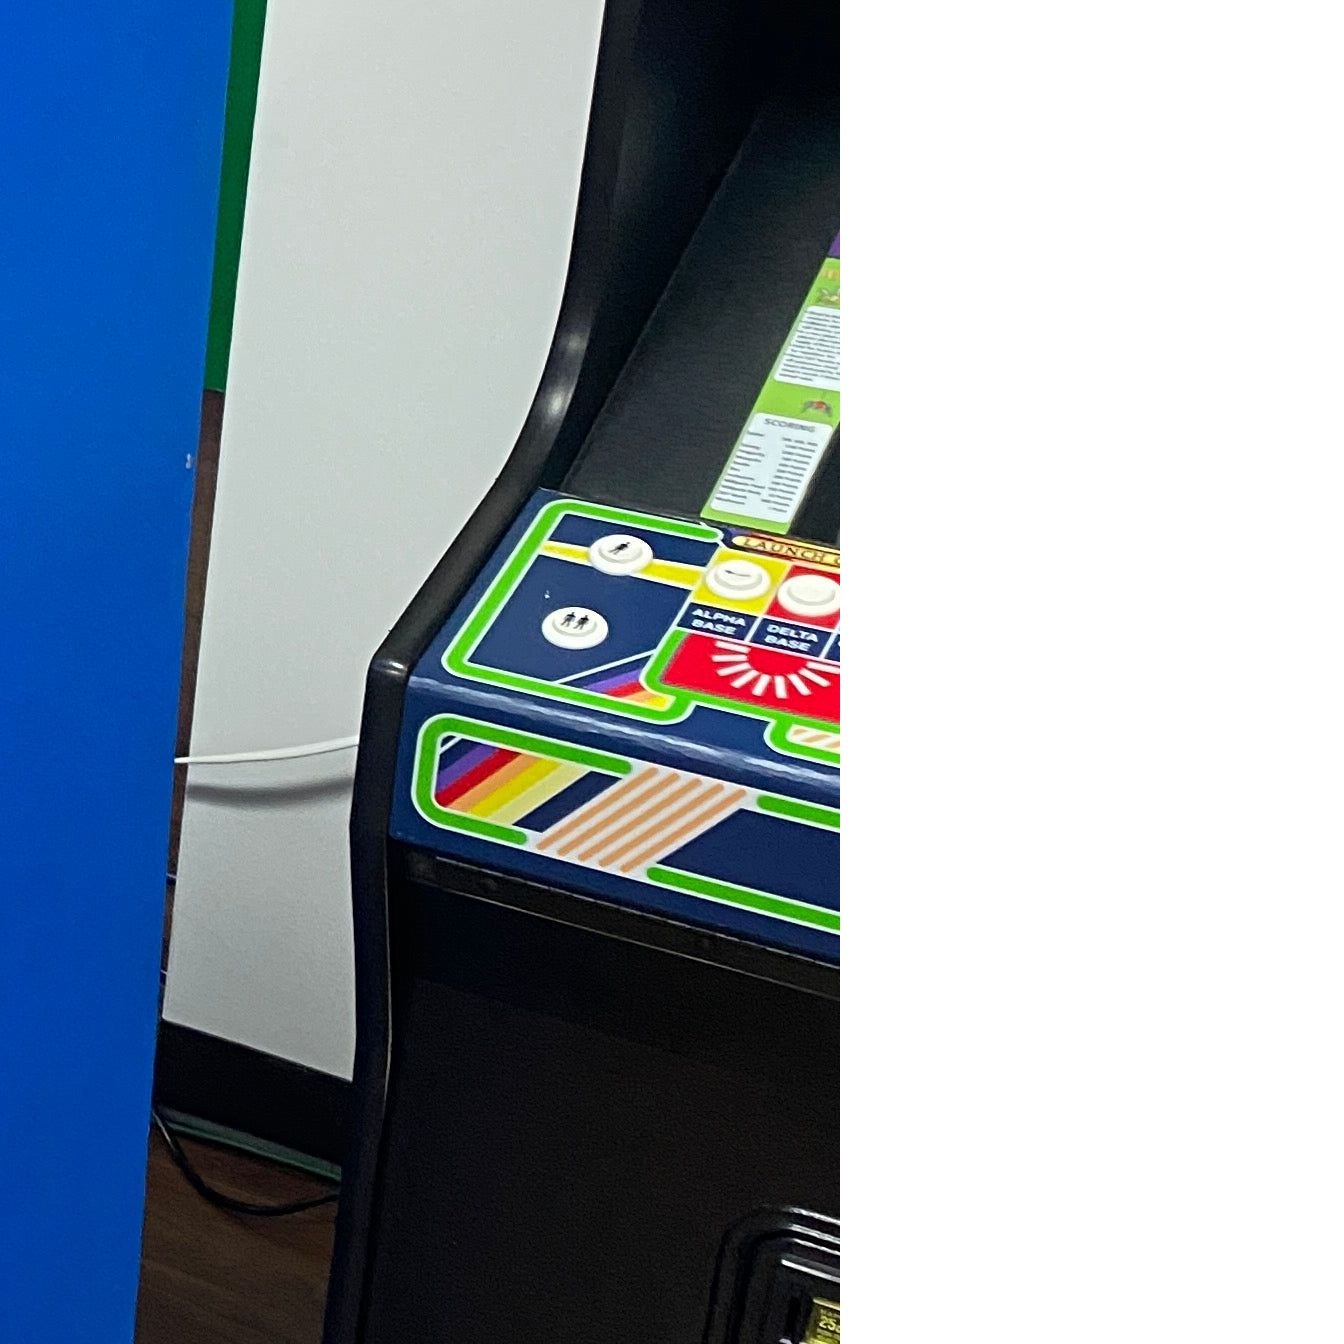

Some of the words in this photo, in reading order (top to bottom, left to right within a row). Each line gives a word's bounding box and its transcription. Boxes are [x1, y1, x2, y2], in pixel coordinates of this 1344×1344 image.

[763, 417, 816, 433] SCORING
[743, 537, 831, 564] LAUNCH
[692, 608, 747, 627] ALPHA
[691, 618, 737, 636] BASE
[766, 623, 819, 643] DELTA
[764, 634, 811, 652] BASE
